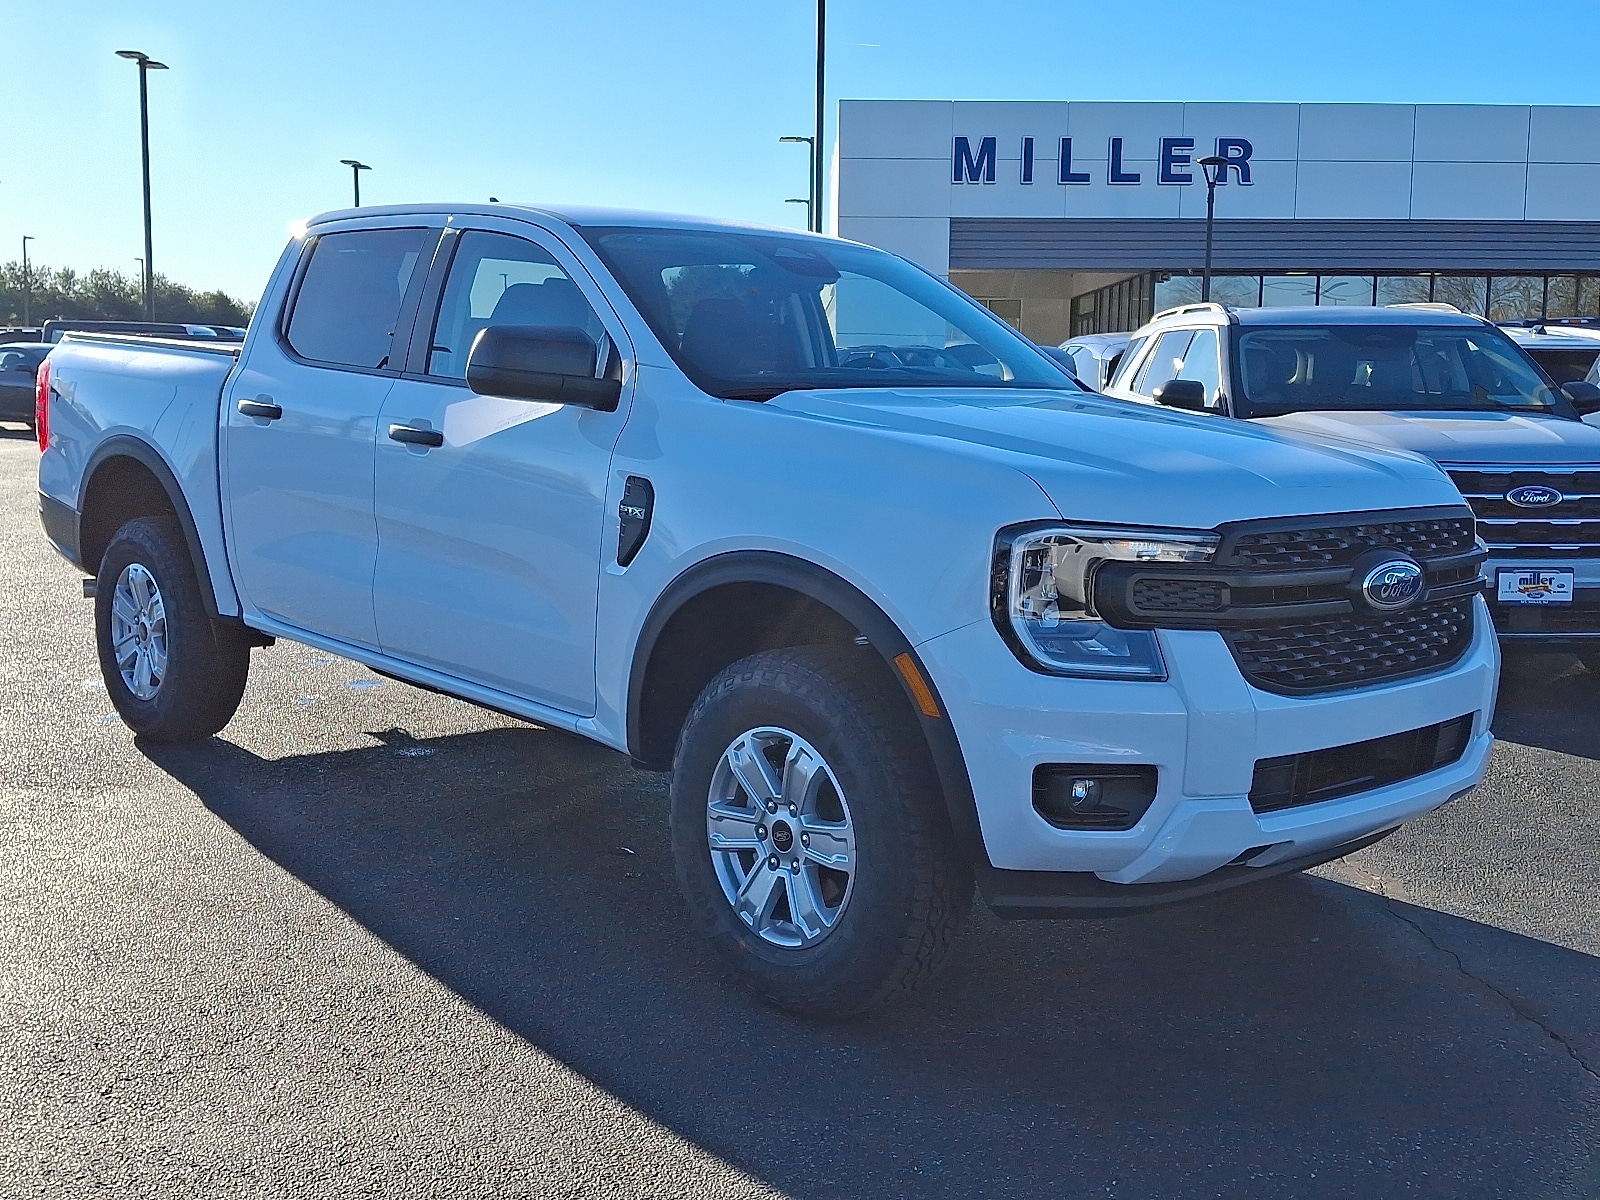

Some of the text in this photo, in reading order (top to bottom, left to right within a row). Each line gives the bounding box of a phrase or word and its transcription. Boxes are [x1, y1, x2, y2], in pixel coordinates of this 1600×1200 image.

[951, 135, 1253, 186] MILLER
[1519, 489, 1550, 503] Ford
[1381, 571, 1414, 598] Ford
[1518, 573, 1555, 586] miller
